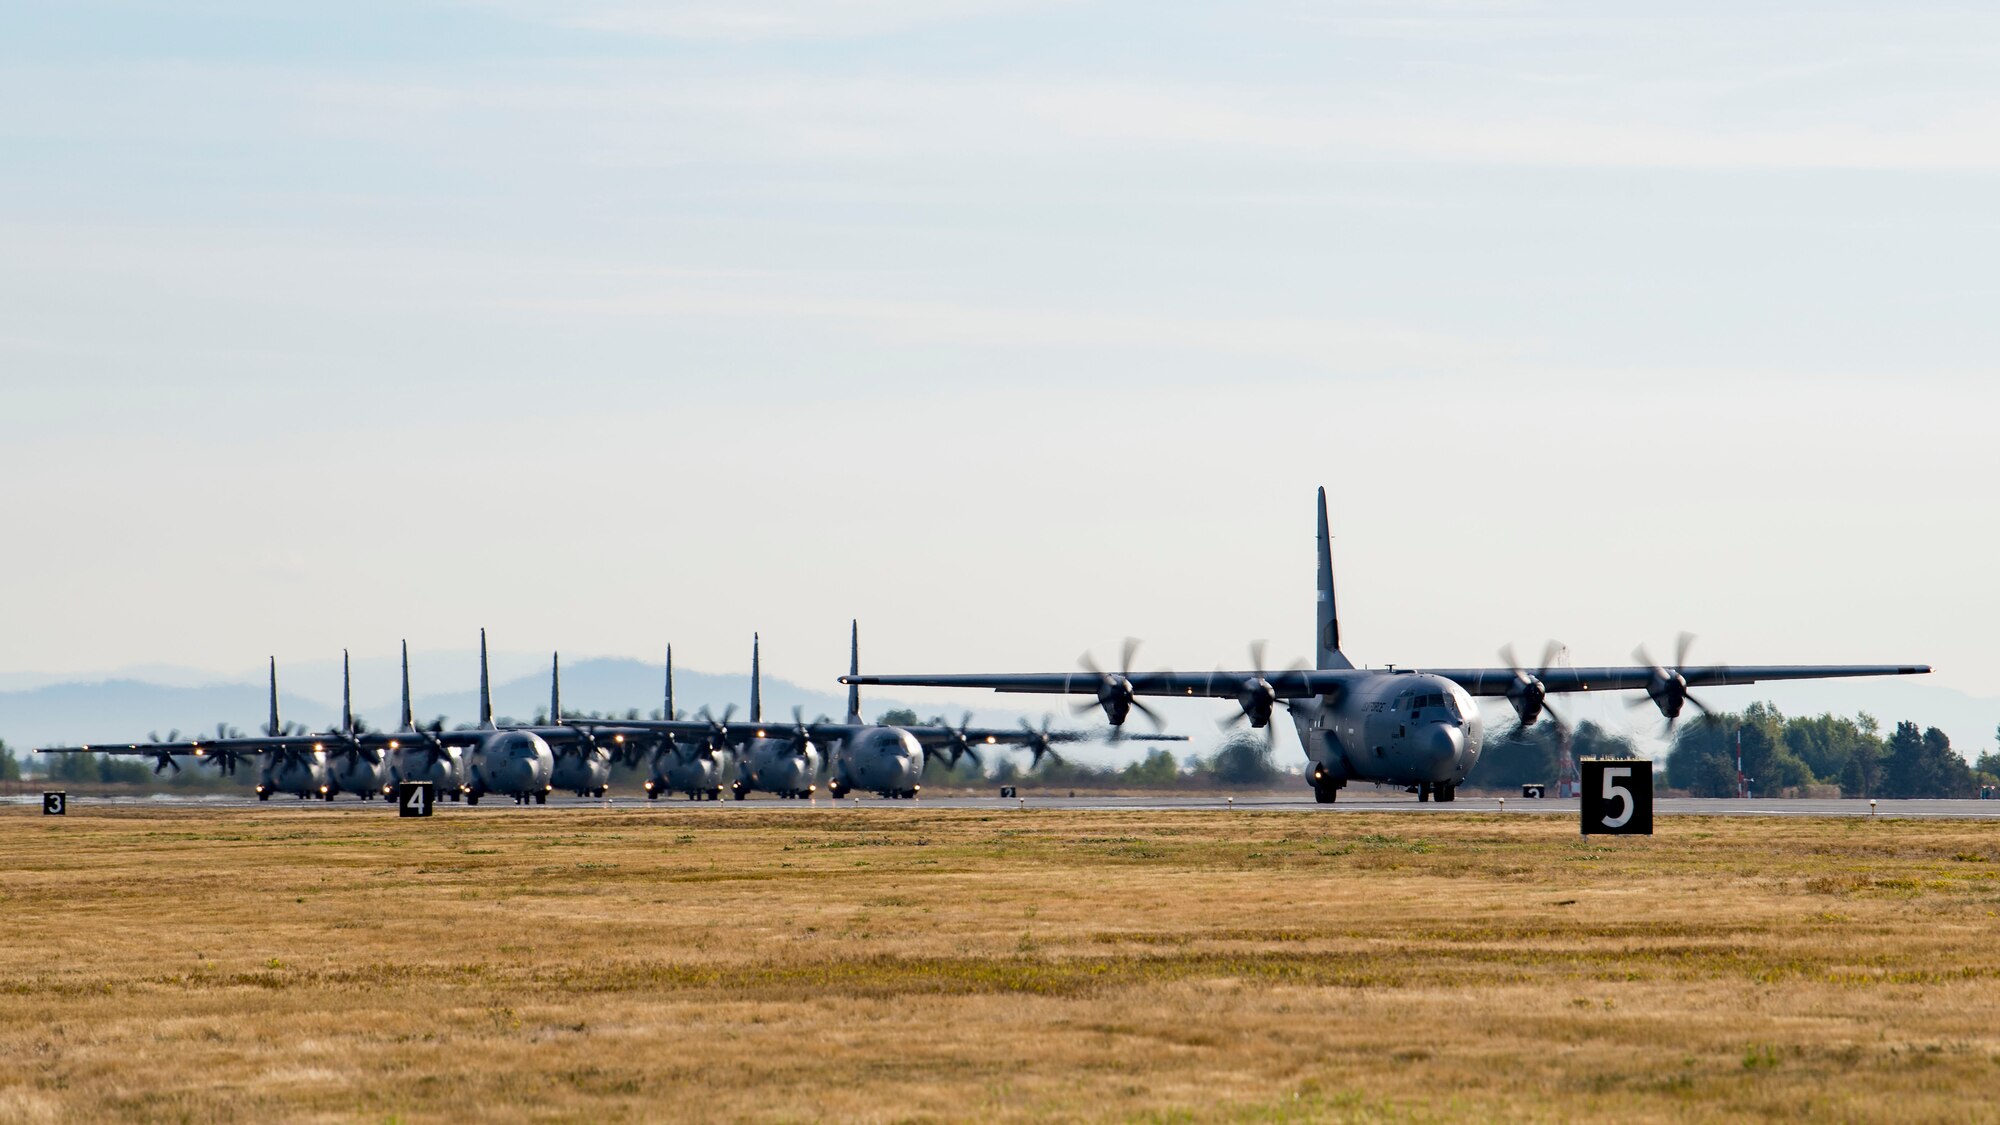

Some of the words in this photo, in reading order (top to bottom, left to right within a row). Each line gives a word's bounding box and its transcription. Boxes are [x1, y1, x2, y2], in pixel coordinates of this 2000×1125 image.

[48, 794, 62, 814] 3
[407, 786, 425, 814] 4
[1601, 767, 1634, 828] 5
